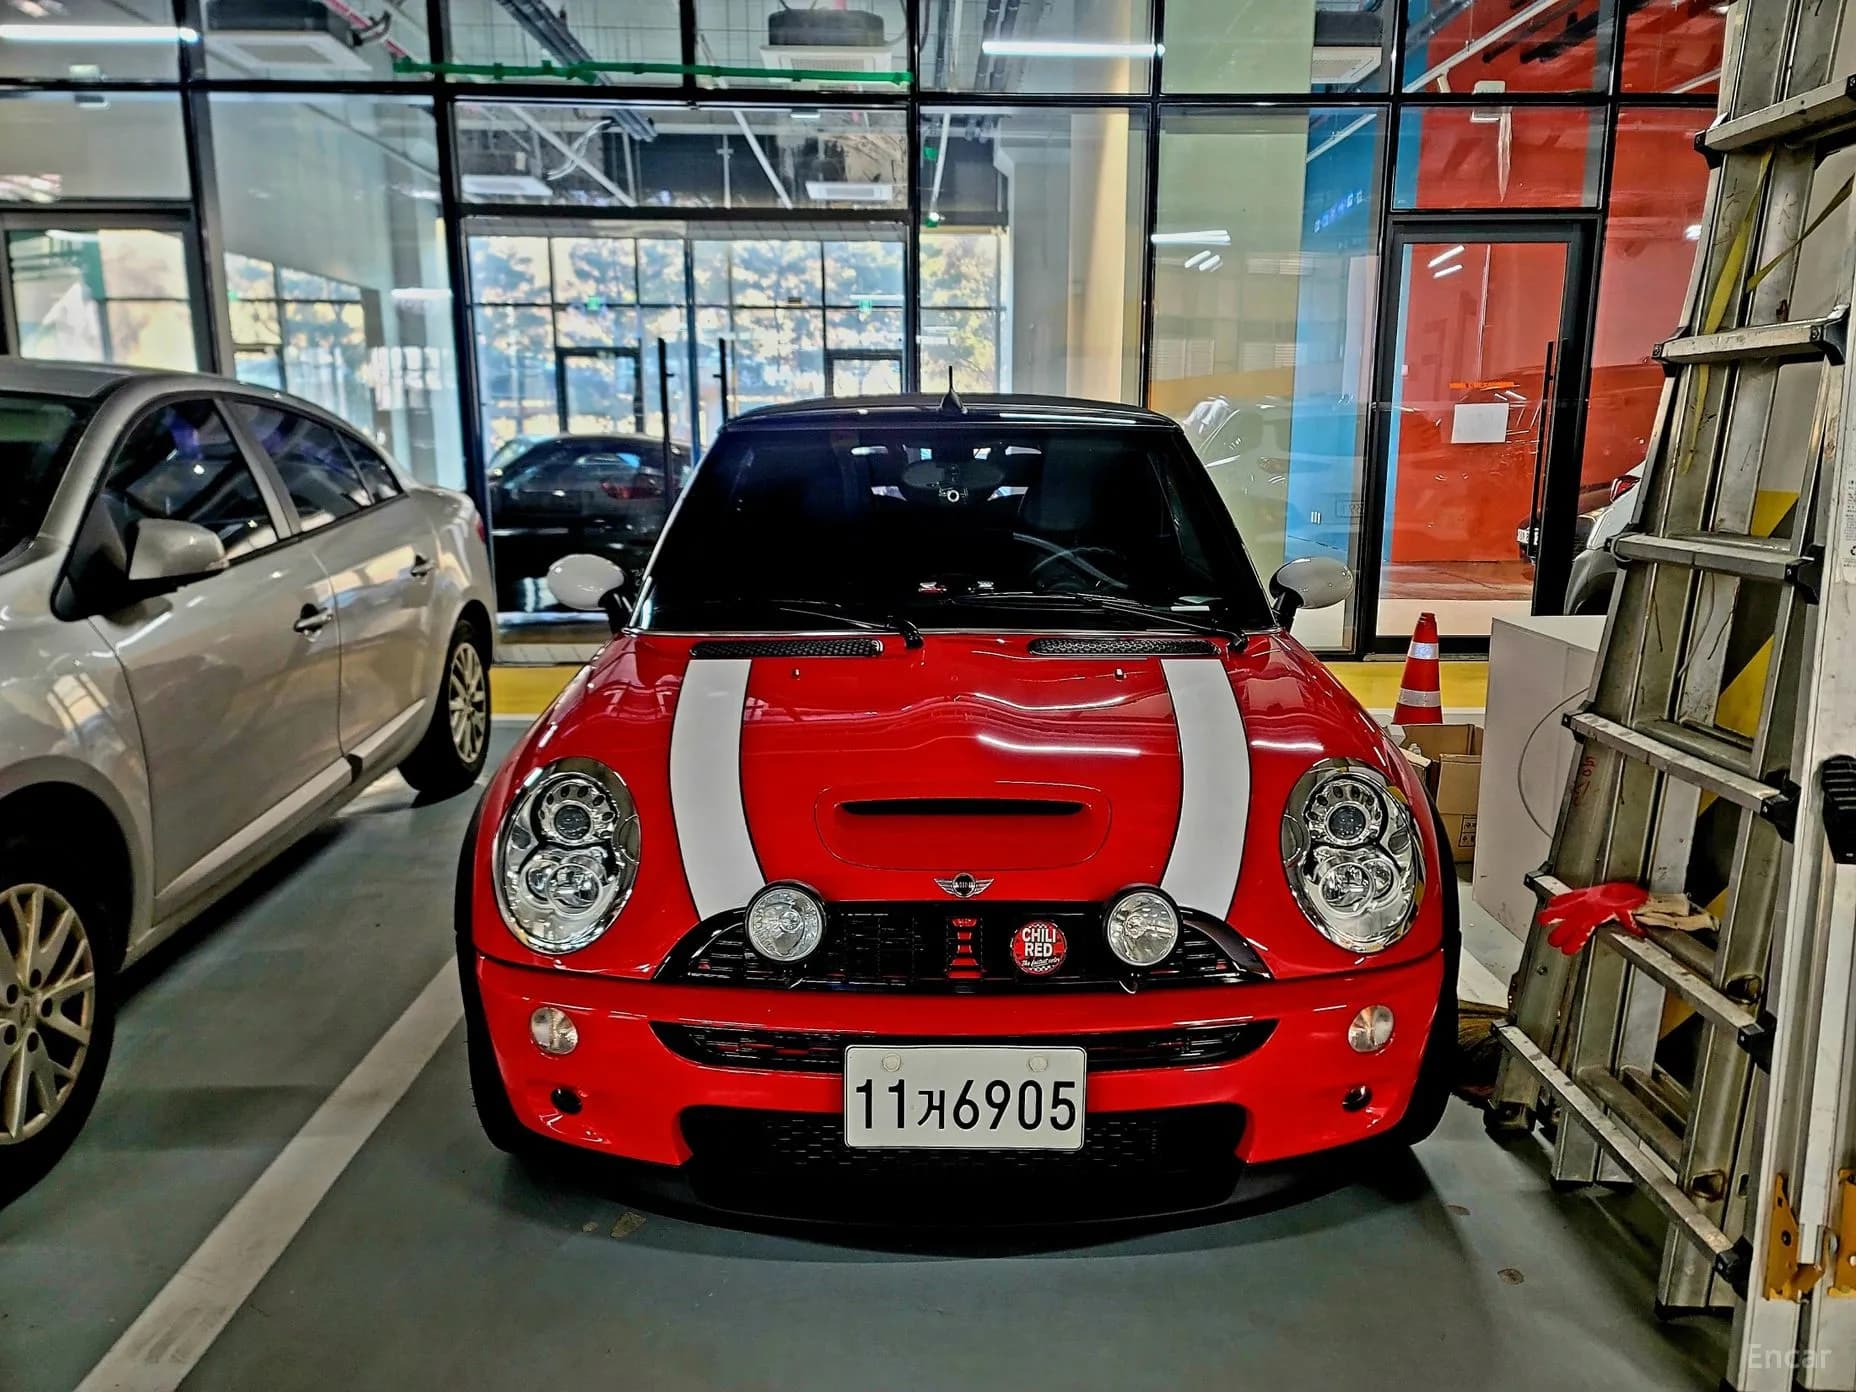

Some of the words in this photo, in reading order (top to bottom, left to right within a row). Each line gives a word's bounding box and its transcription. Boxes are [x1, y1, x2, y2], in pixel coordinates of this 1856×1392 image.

[1021, 927, 1057, 943] CHILI
[1024, 942, 1053, 957] RED
[855, 1078, 1076, 1131] 11거6905
